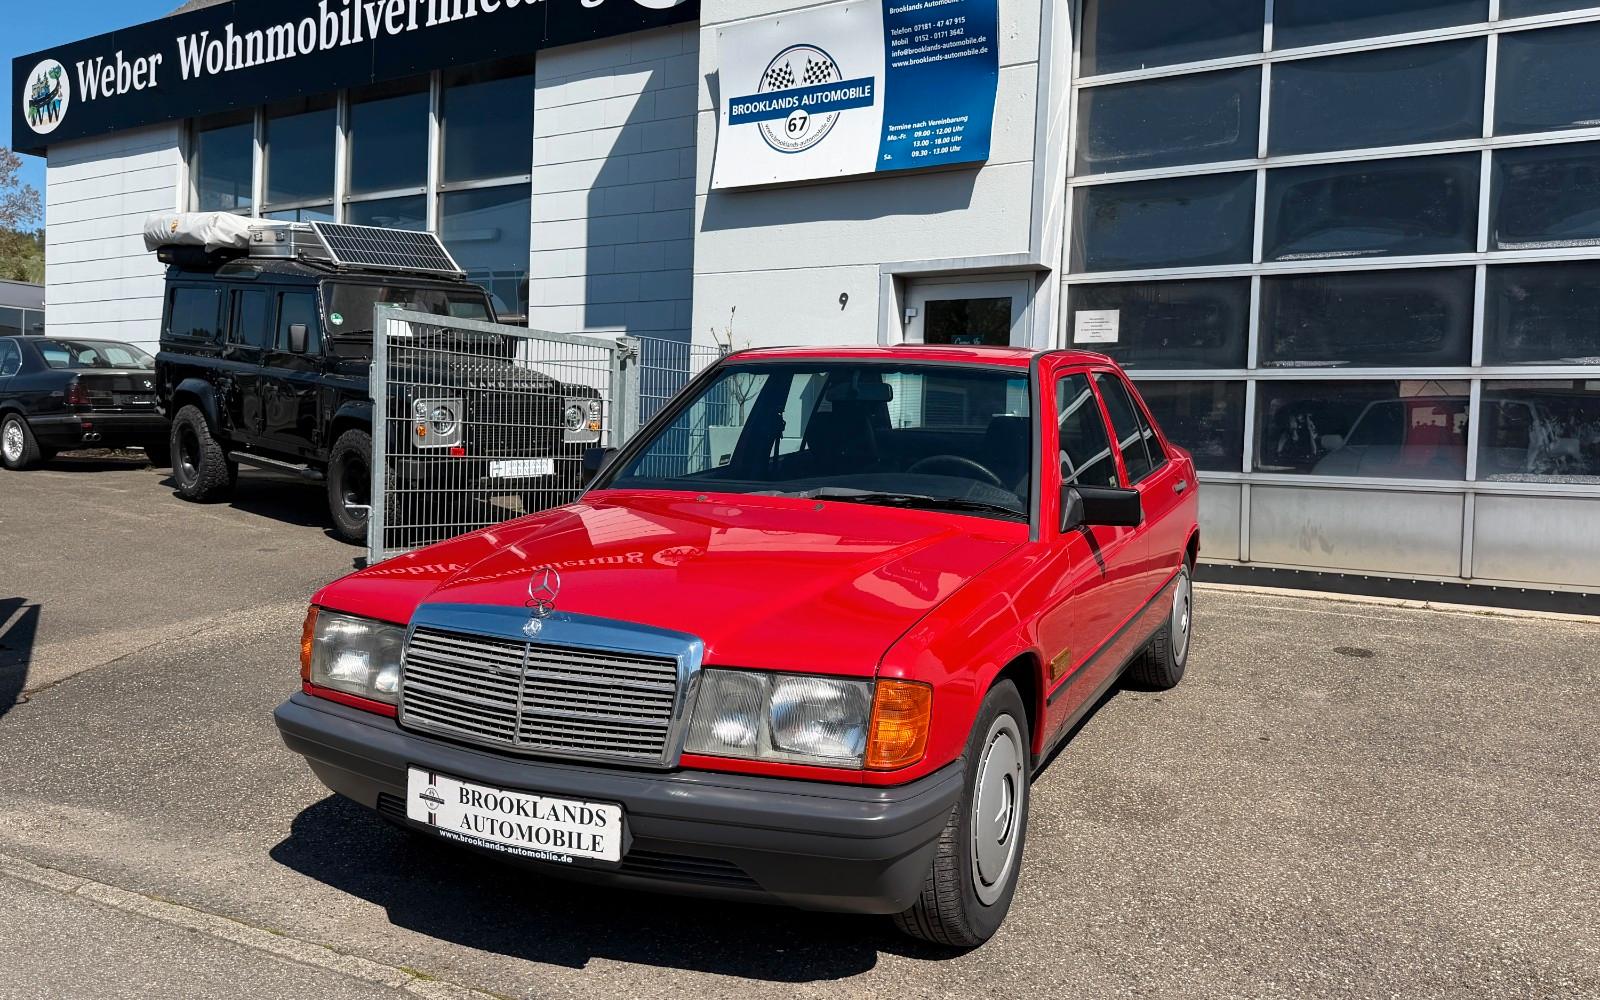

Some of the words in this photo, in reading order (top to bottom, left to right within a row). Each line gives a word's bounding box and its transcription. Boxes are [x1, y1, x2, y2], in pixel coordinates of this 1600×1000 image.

[889, 3, 922, 14] Brooklands
[890, 26, 912, 36] Telefon
[914, 23, 932, 32] 07181
[946, 18, 953, 26] 47
[954, 16, 966, 25] 915
[891, 38, 909, 46] Mobil
[914, 34, 930, 42] 0152
[934, 30, 948, 40] 0171
[891, 36, 986, 58] info@brooklands-automobile.de
[892, 46, 988, 68] www.brooklands-automobile.de
[76, 50, 162, 103] Weber
[732, 96, 799, 116] BROOKLANDS
[801, 85, 871, 106] AUTOMOBILE
[788, 116, 808, 132] 67
[888, 124, 912, 132] Termine
[912, 120, 926, 128] nach
[839, 292, 849, 311] 9
[459, 786, 607, 828] BROOKLANDS
[460, 812, 605, 853] AUTOMOBILE
[440, 828, 573, 864] www.brooklands-automobile.de
